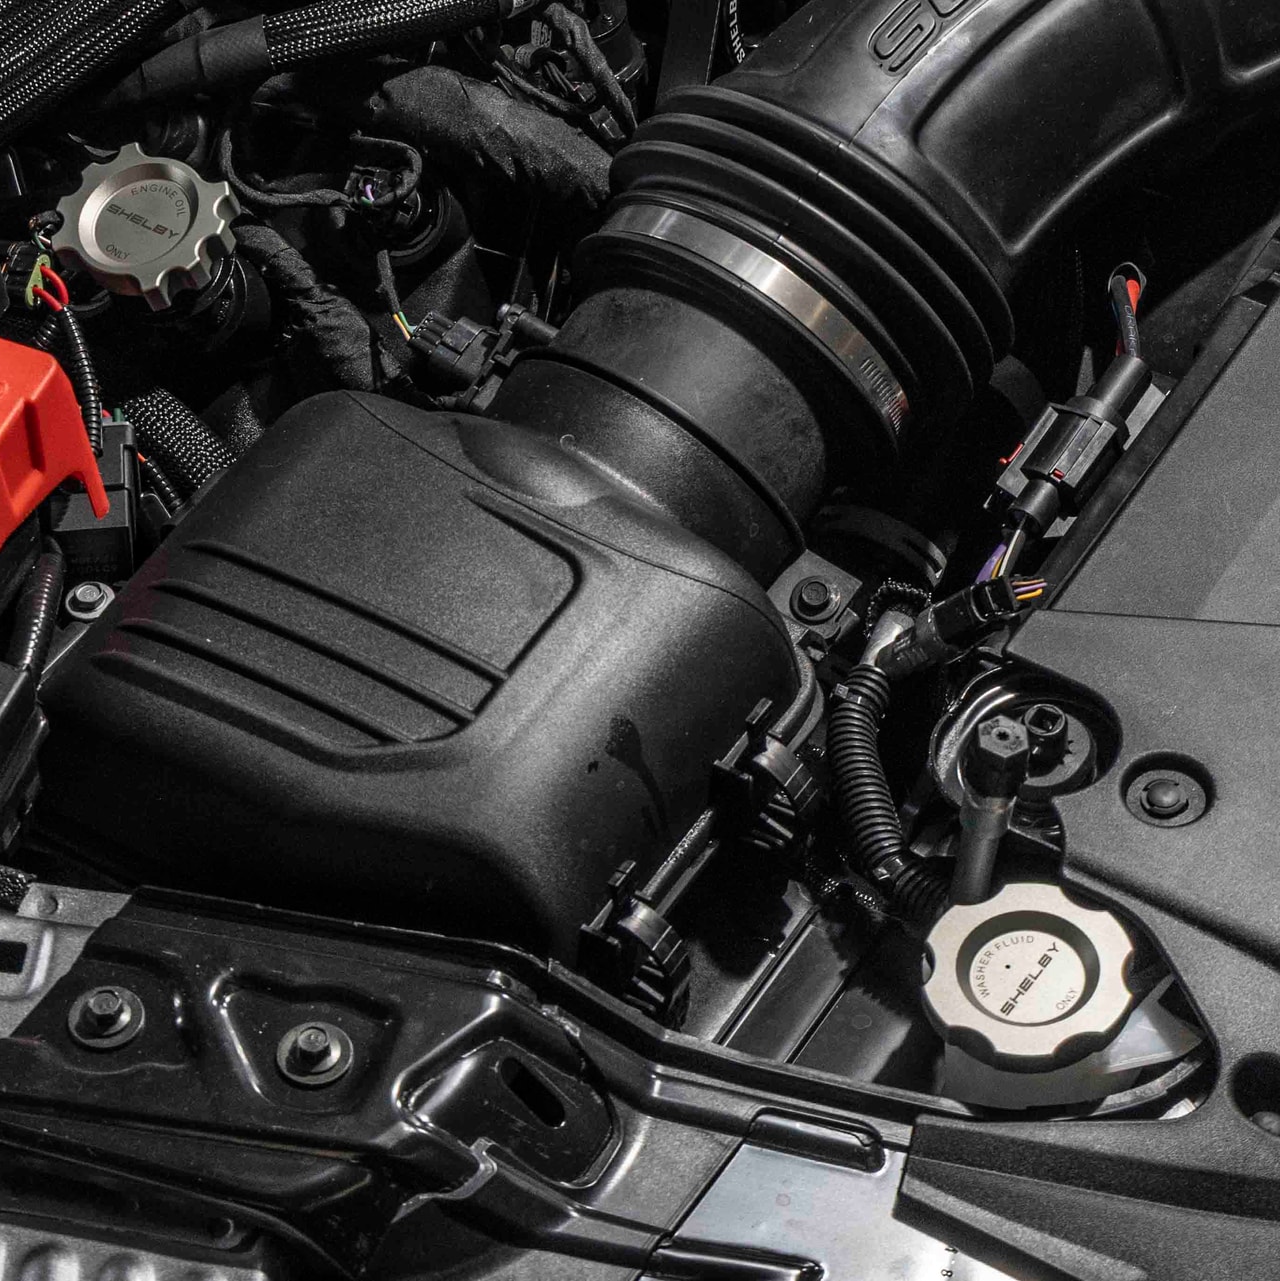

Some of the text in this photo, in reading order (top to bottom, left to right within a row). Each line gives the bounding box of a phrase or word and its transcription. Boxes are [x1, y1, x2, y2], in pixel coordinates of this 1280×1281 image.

[130, 183, 187, 218] ENGINE OIL
[106, 203, 180, 239] SHELBY
[105, 244, 131, 260] ONLY
[976, 934, 1035, 999] WASHER FLUID
[1000, 941, 1060, 1017] SHELBY
[1055, 987, 1078, 1011] ONLY
